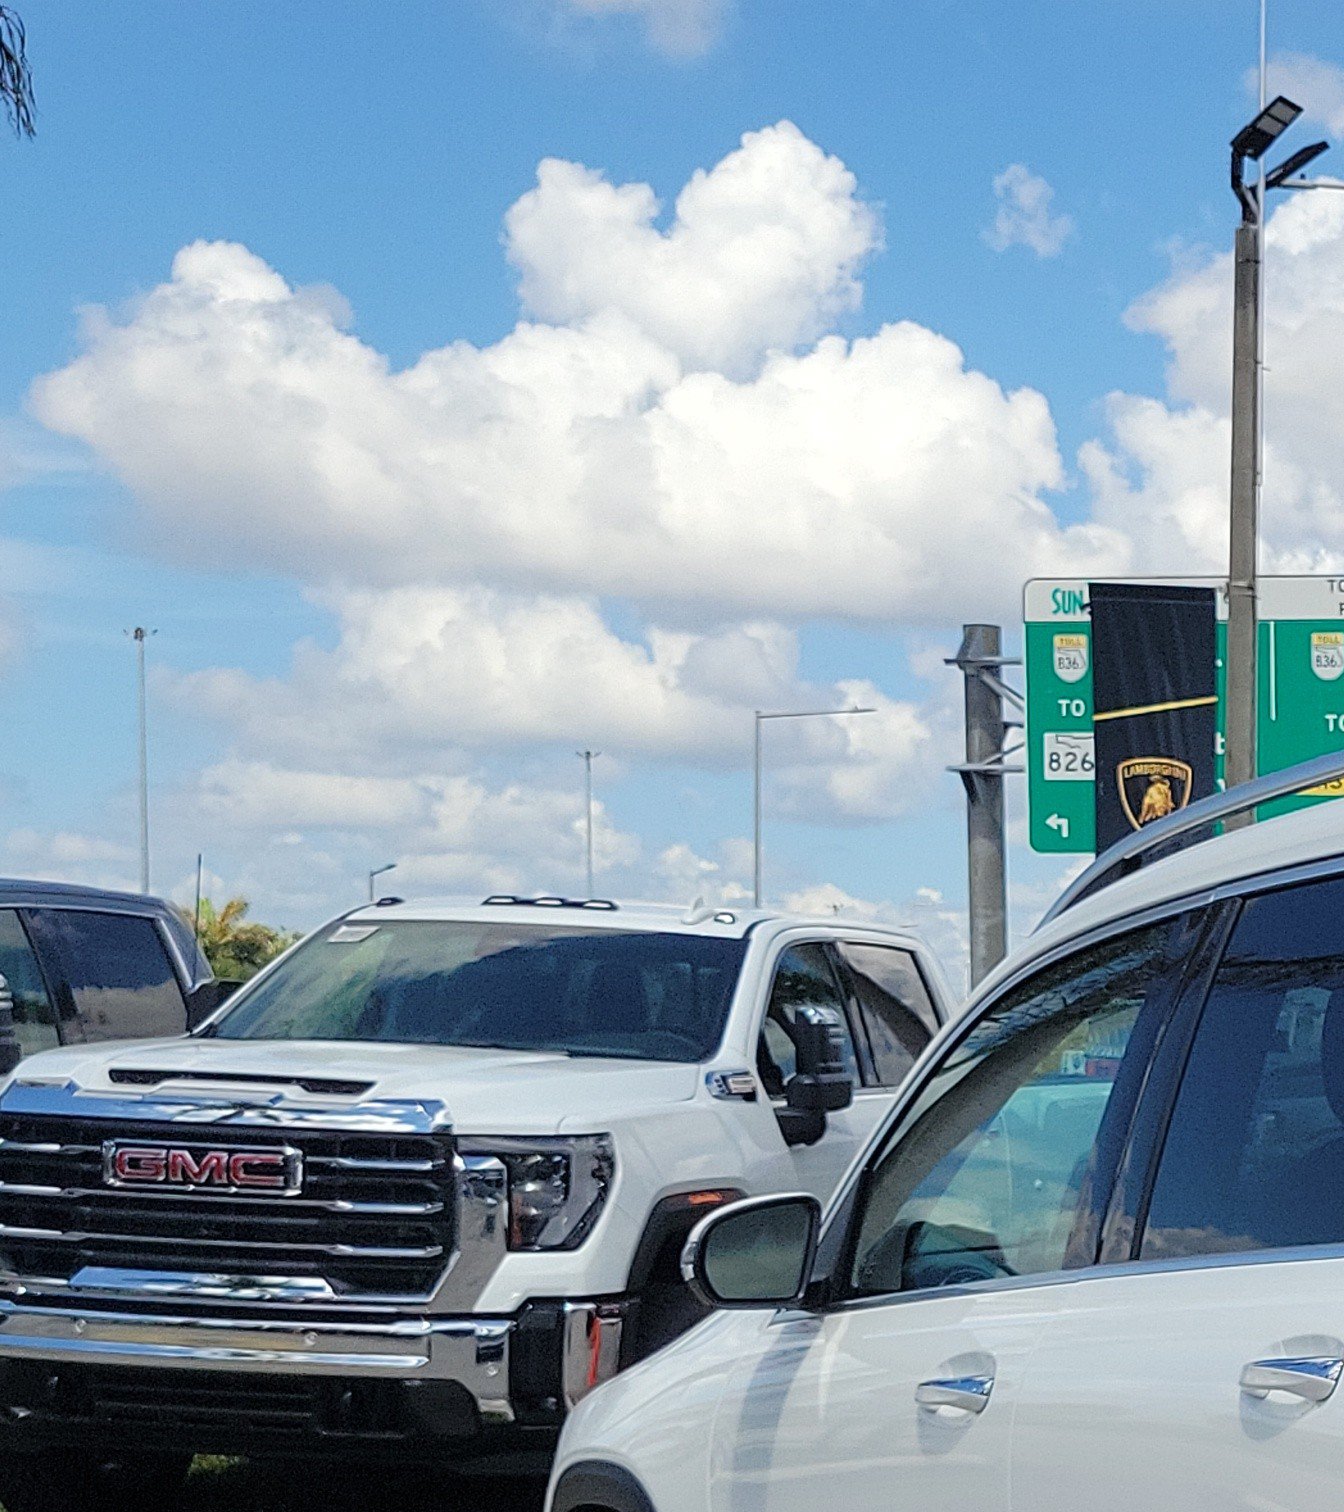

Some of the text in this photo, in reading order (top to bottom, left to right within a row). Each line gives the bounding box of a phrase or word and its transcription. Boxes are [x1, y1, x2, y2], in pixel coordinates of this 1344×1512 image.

[1315, 654, 1338, 668] 836
[1058, 699, 1086, 717] TO
[1049, 752, 1094, 772] 826
[114, 1148, 286, 1187] GMC
